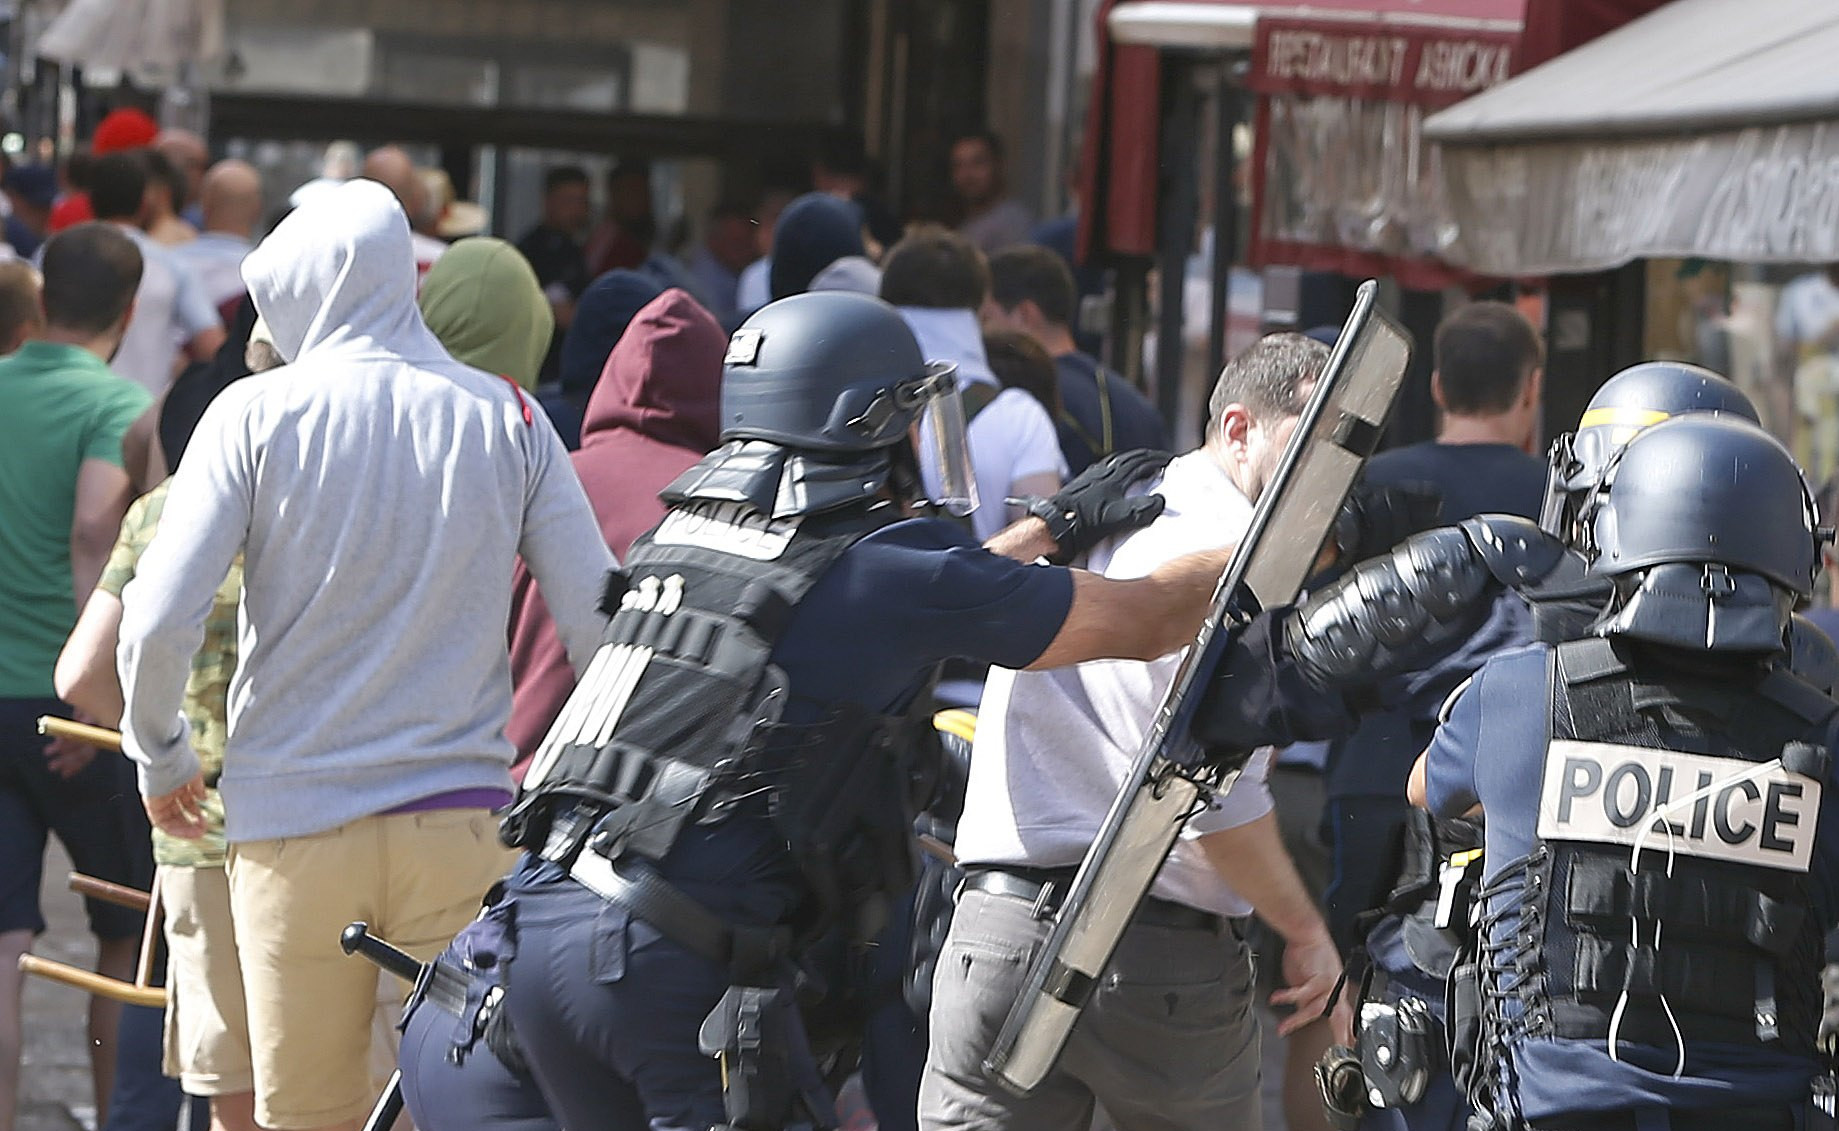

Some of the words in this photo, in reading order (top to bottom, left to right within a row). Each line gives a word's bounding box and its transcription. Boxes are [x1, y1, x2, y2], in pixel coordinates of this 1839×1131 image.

[1266, 30, 1407, 87] RESTAURANT
[662, 501, 800, 550] POLICE
[1557, 757, 1803, 853] POLICE
